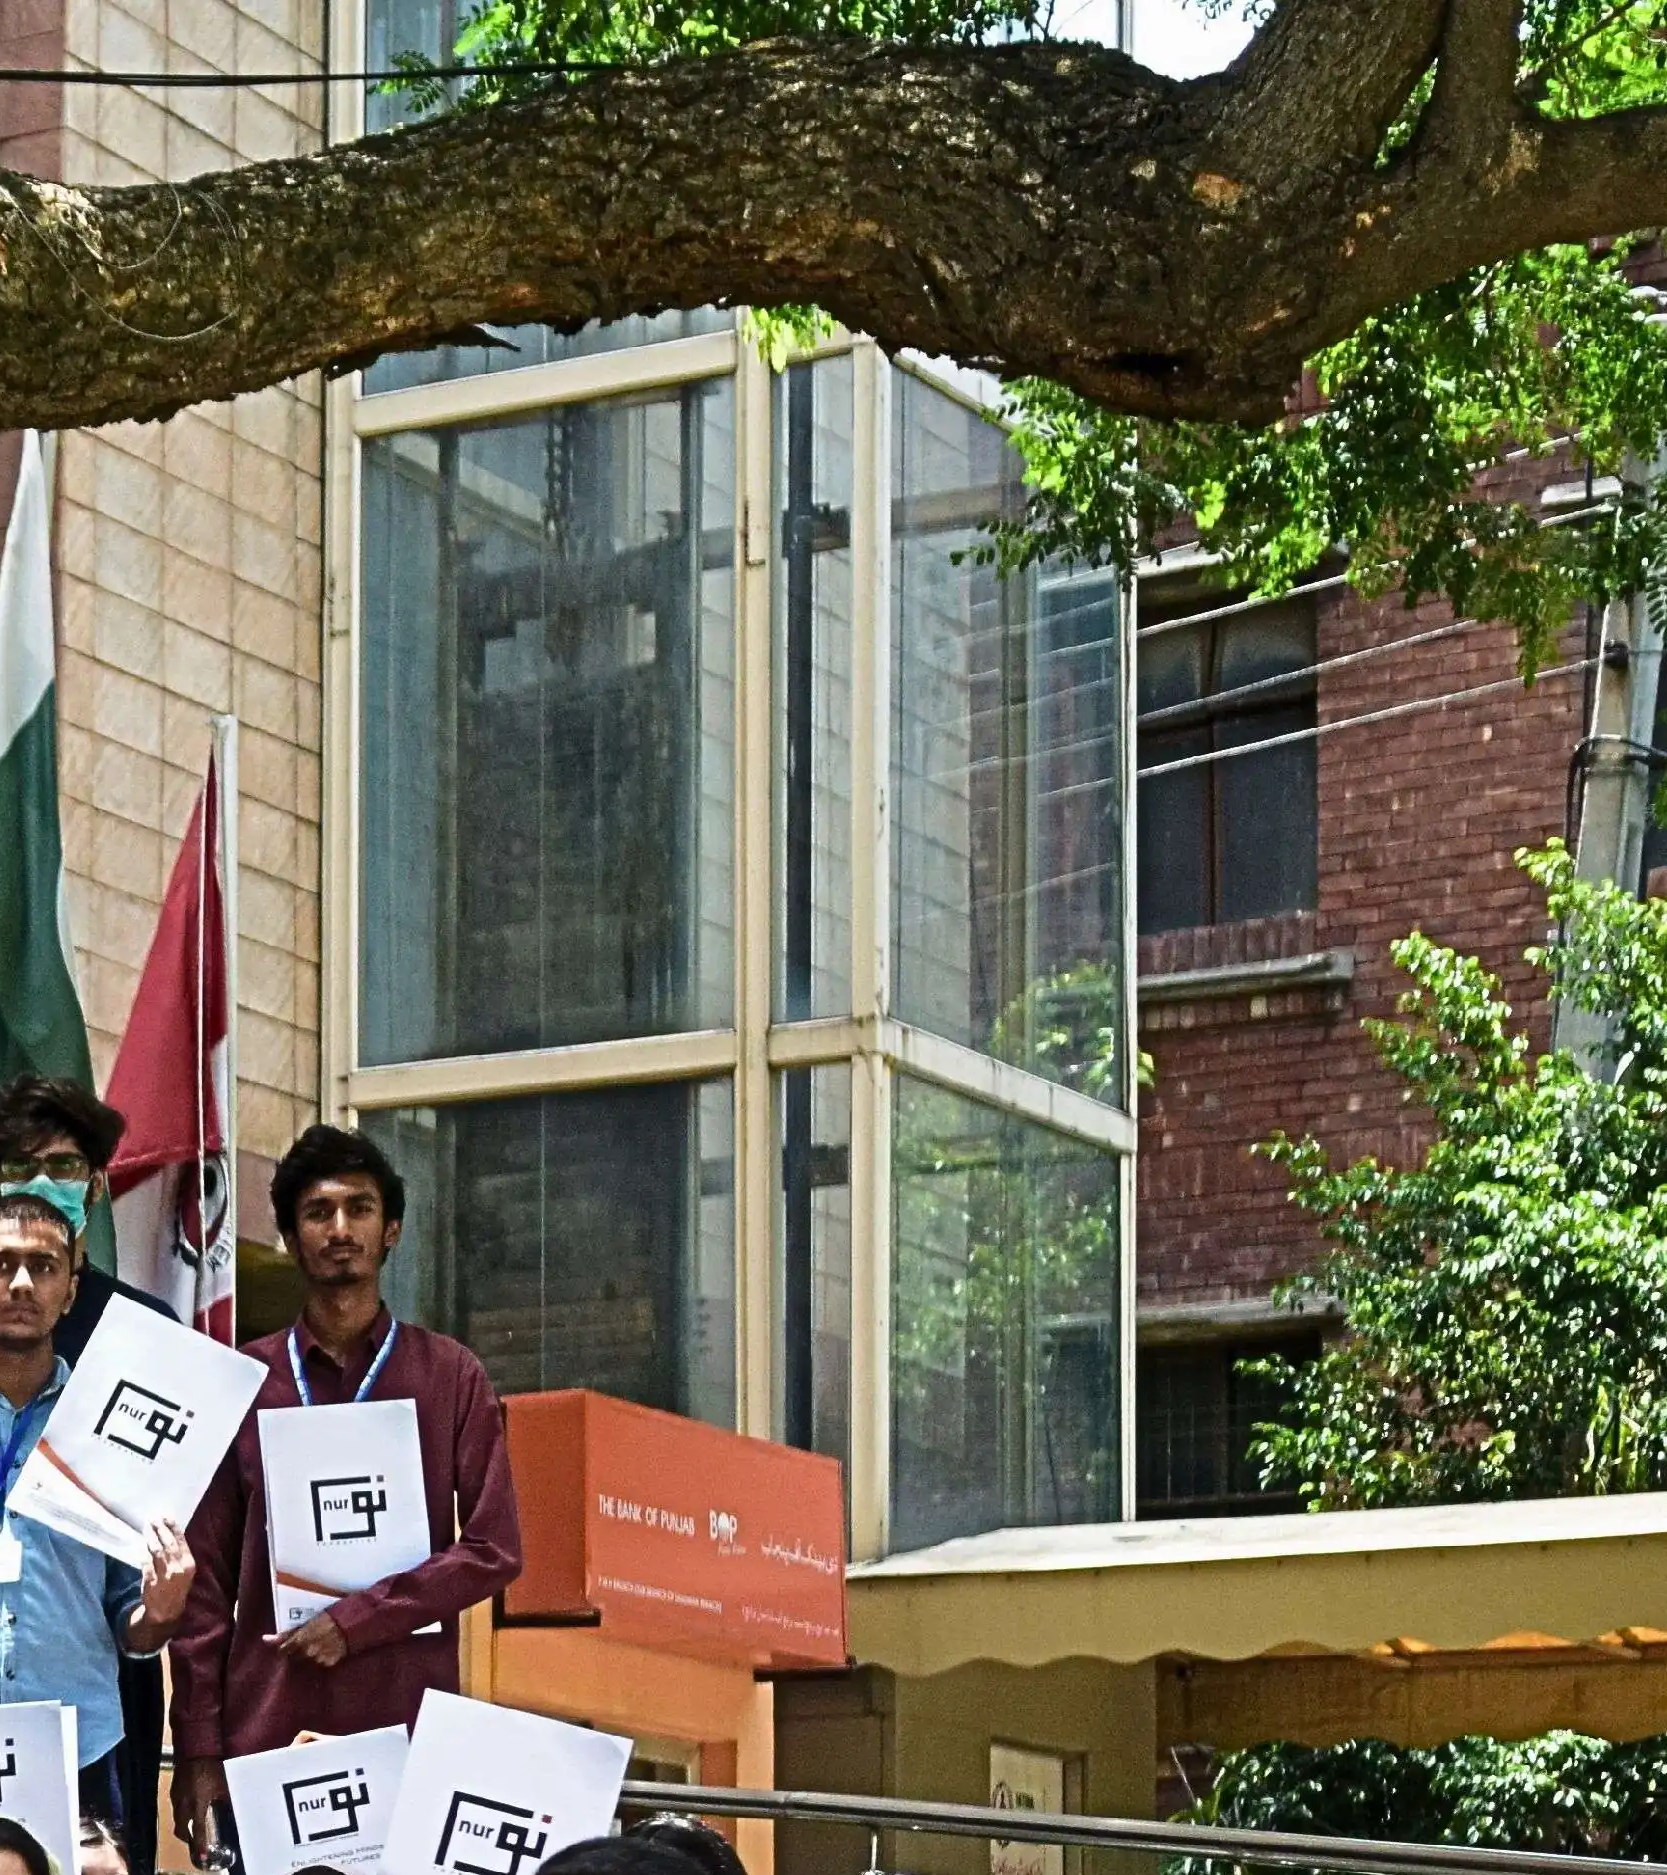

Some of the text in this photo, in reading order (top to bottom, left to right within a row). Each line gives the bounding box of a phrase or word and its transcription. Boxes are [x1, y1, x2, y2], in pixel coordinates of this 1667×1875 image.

[118, 1400, 147, 1421] nur
[323, 1498, 349, 1511] nur
[598, 1494, 695, 1537] THE BANK OF PUNJAB
[298, 1796, 327, 1813] nur
[459, 1817, 495, 1841] nur
